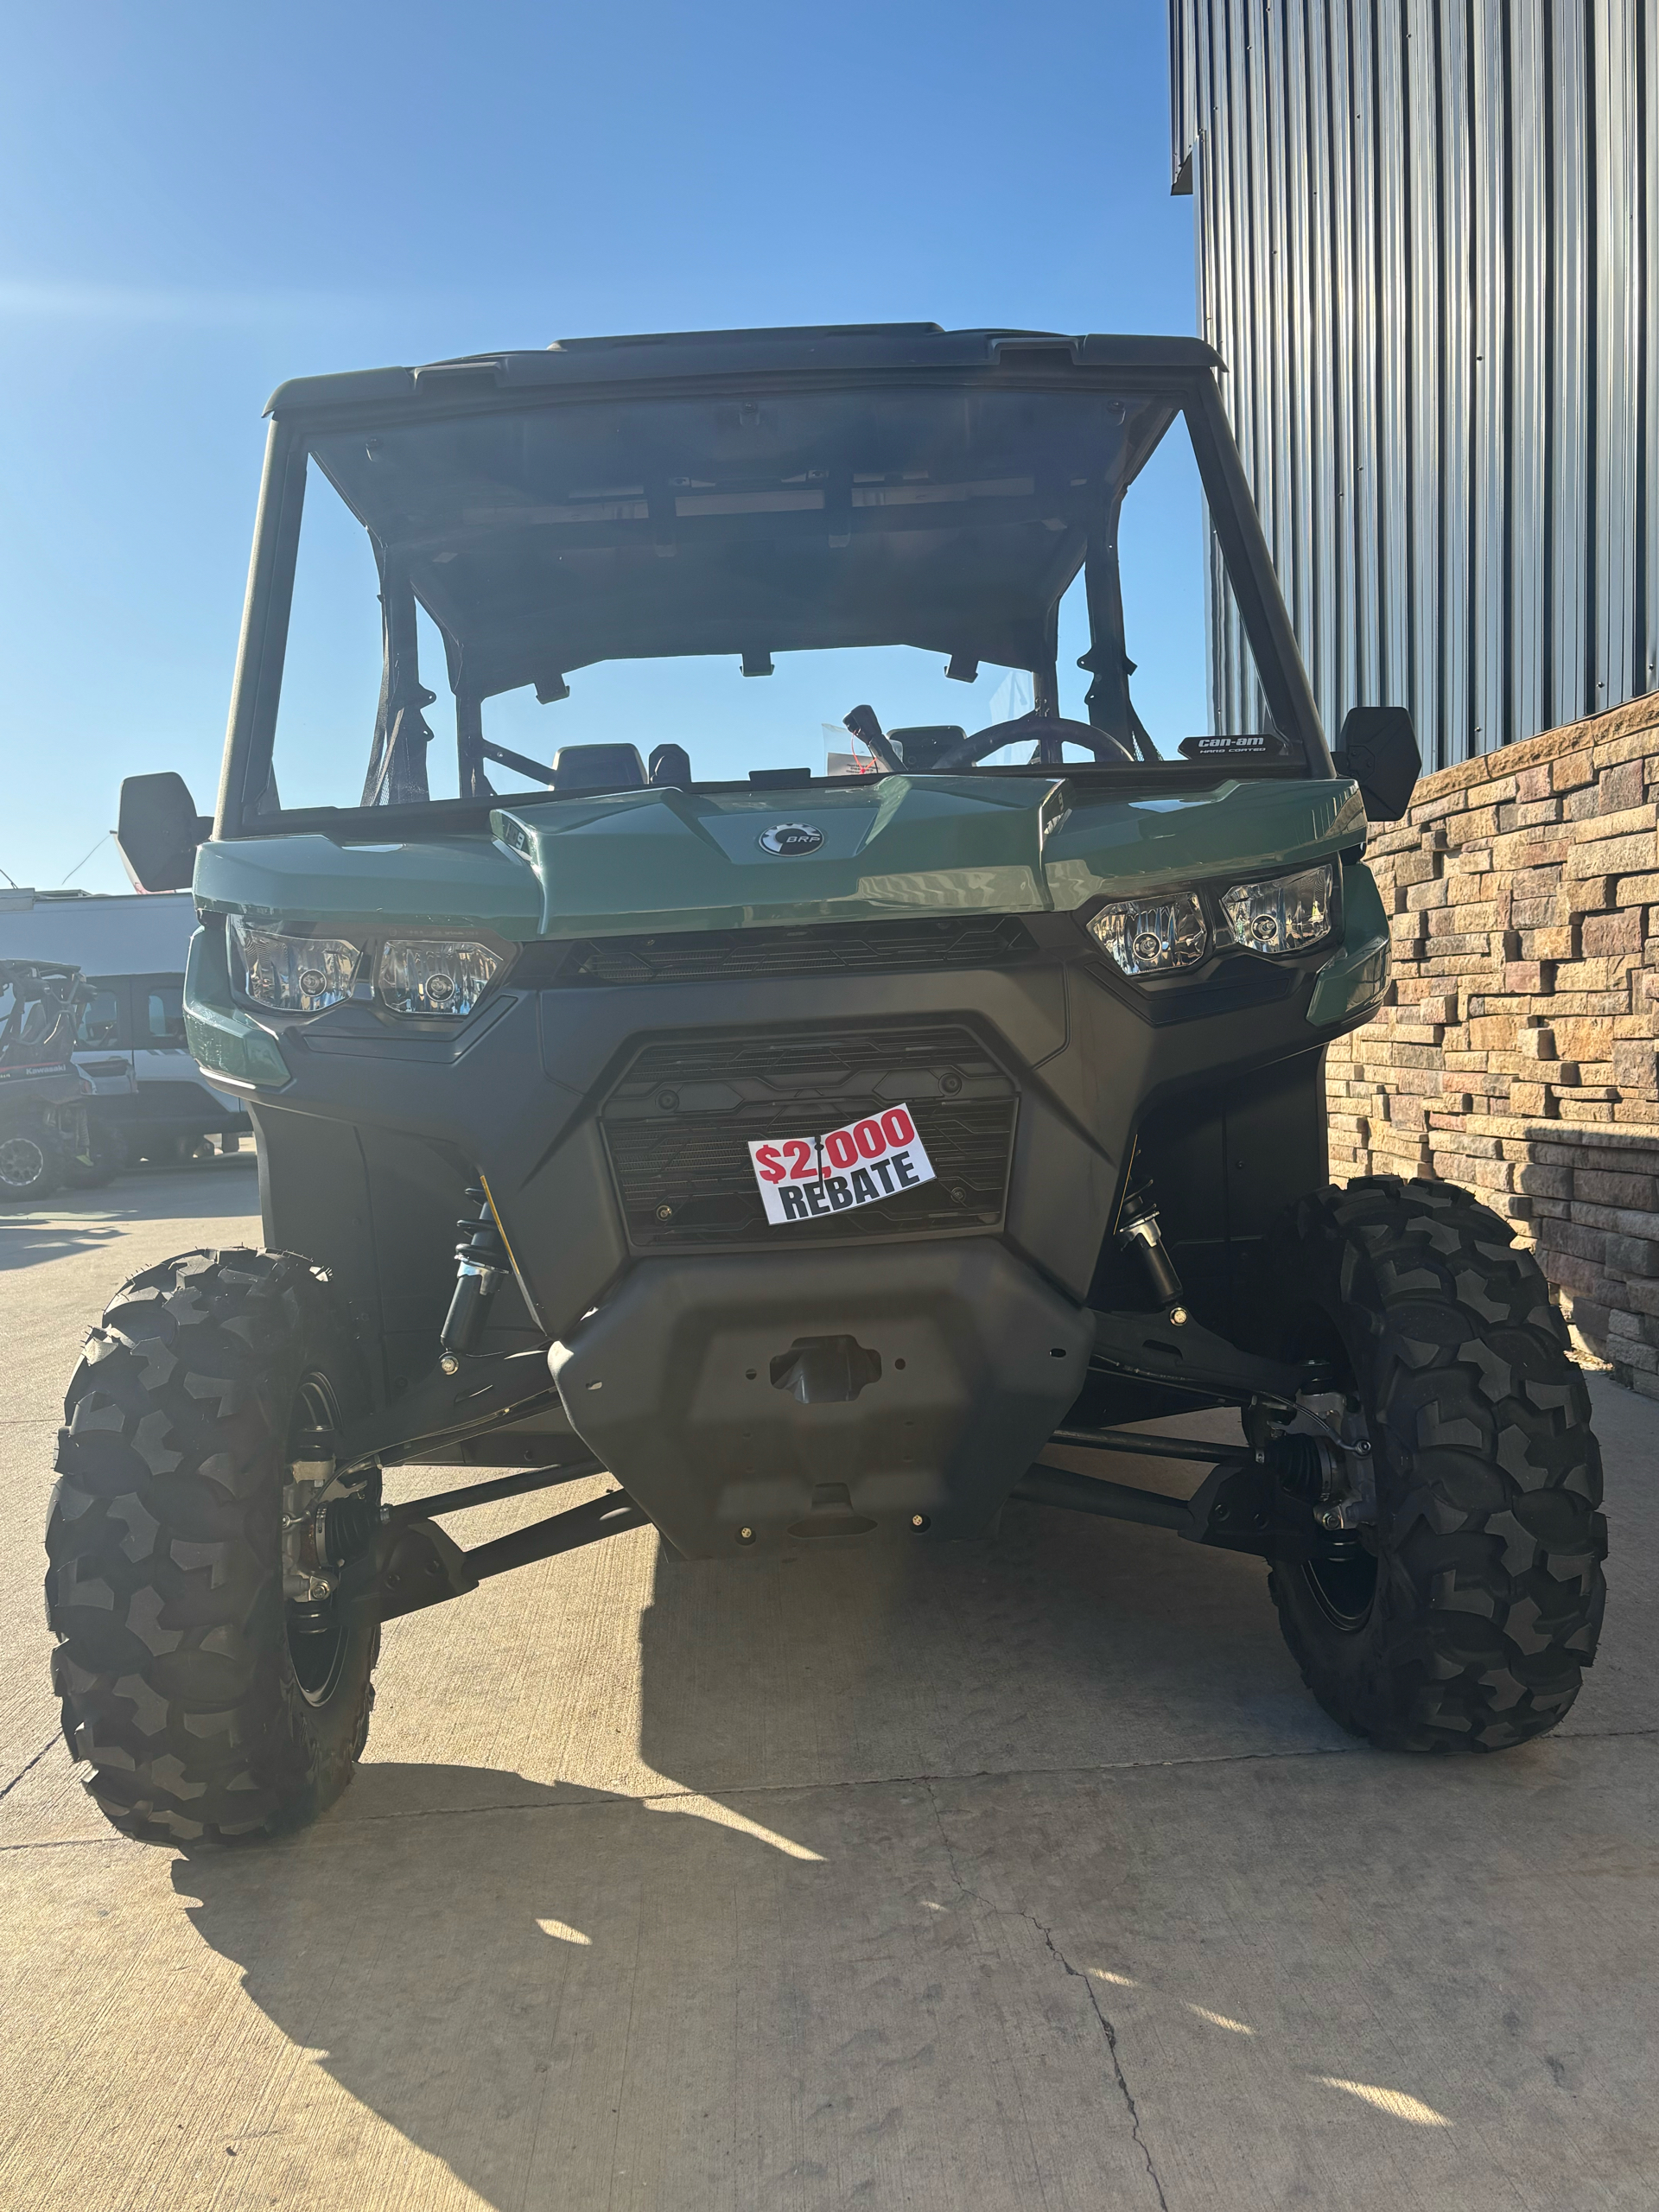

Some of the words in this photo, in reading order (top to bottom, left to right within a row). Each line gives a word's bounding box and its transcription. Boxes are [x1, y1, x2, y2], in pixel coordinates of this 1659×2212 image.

[1198, 737, 1264, 747] can-am
[25, 1064, 67, 1075] Kawasaki
[755, 1109, 915, 1185] $2,000
[778, 1151, 921, 1221] REBATE
